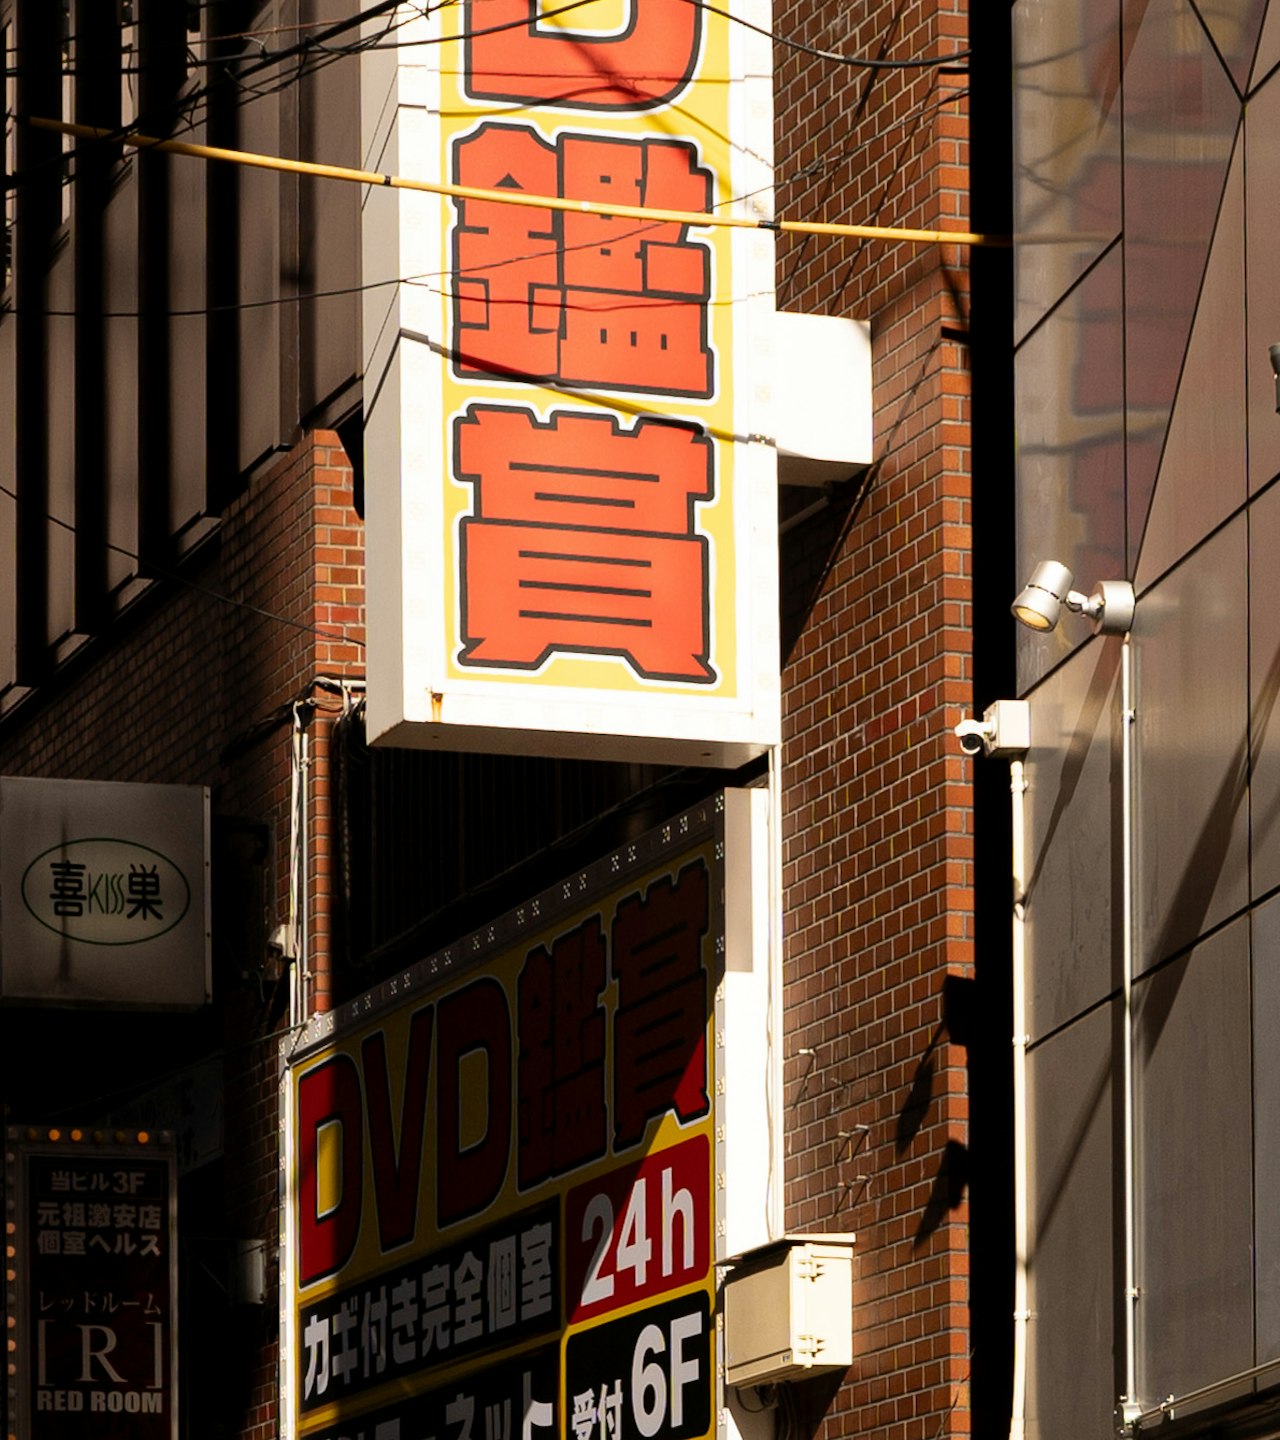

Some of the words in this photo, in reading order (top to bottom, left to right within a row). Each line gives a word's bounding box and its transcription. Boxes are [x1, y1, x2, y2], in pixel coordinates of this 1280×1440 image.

[298, 858, 710, 1288] DVD鑑賞
[37, 1202, 162, 1229] 元祖激安店
[37, 1230, 162, 1257] 個室ヘルス
[579, 1167, 695, 1307] 24h
[38, 1291, 163, 1317] レッドルーム
[304, 1222, 553, 1401] カギ付き完全個室
[37, 1390, 83, 1412] RED
[90, 1390, 163, 1414] ROOM
[631, 1311, 703, 1438] 6F
